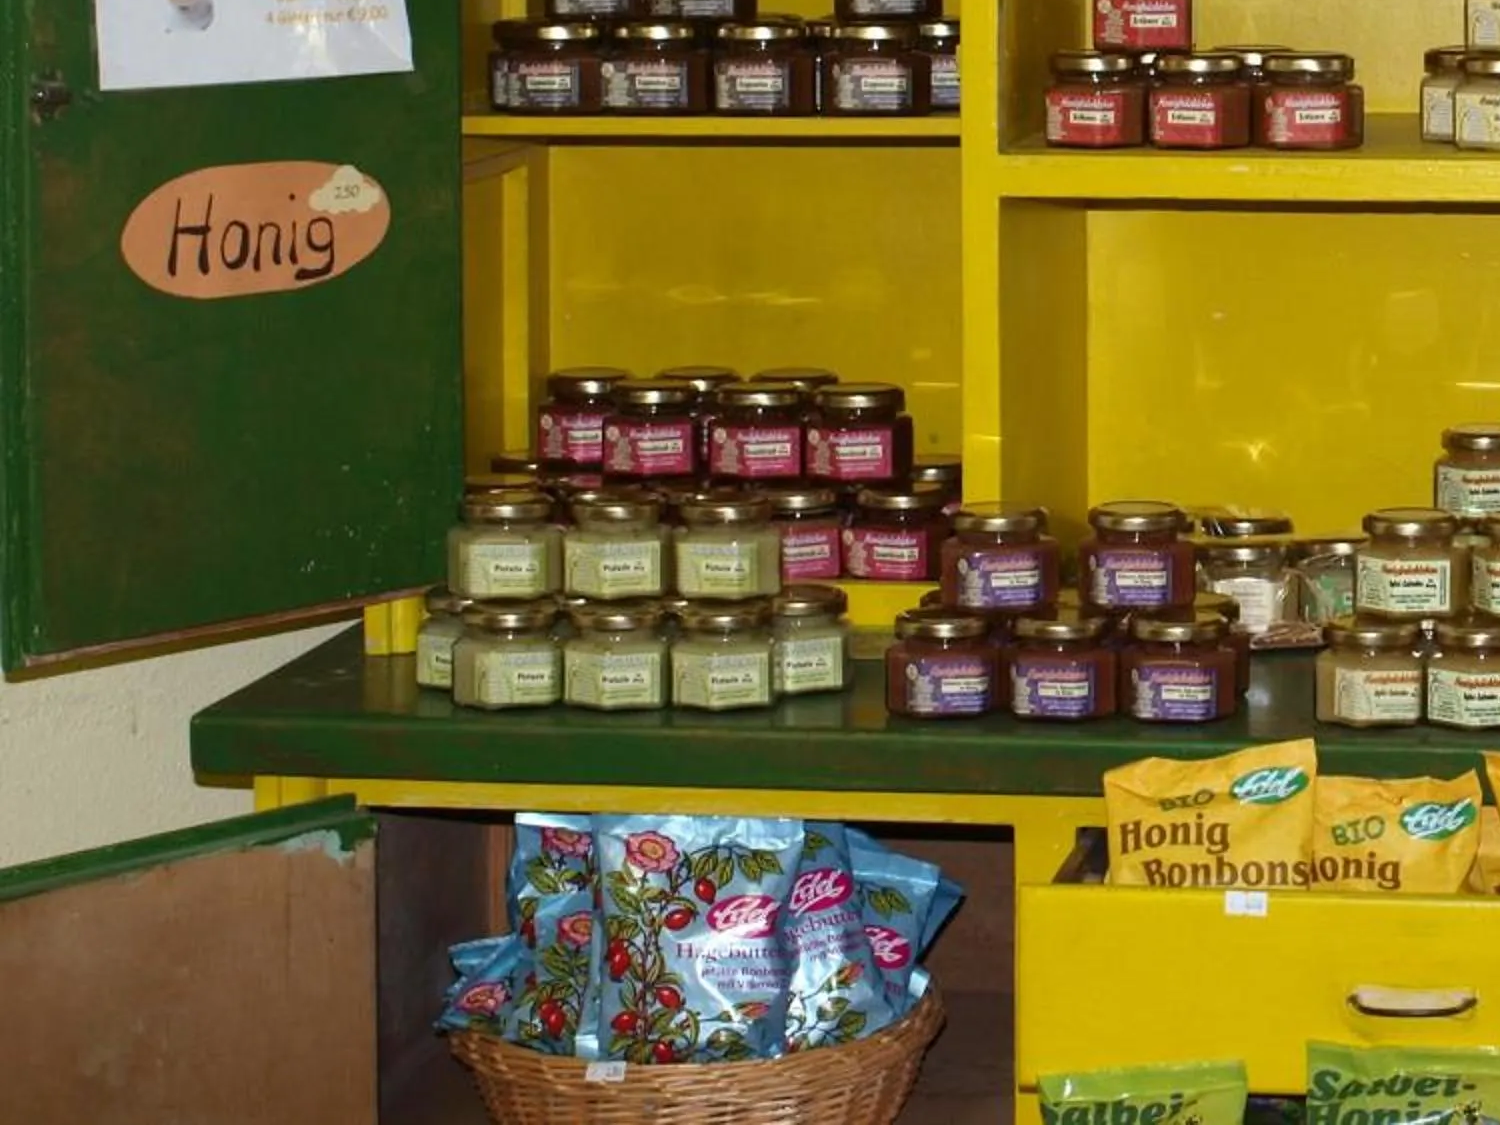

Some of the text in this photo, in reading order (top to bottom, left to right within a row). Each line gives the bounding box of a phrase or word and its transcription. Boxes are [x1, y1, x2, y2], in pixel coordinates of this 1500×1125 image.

[167, 193, 335, 280] Honig
[1159, 788, 1216, 812] BIO
[1120, 813, 1231, 855] Honig
[1331, 815, 1386, 846] BIO
[1143, 856, 1312, 887] Bonbons
[1309, 851, 1402, 890] onig
